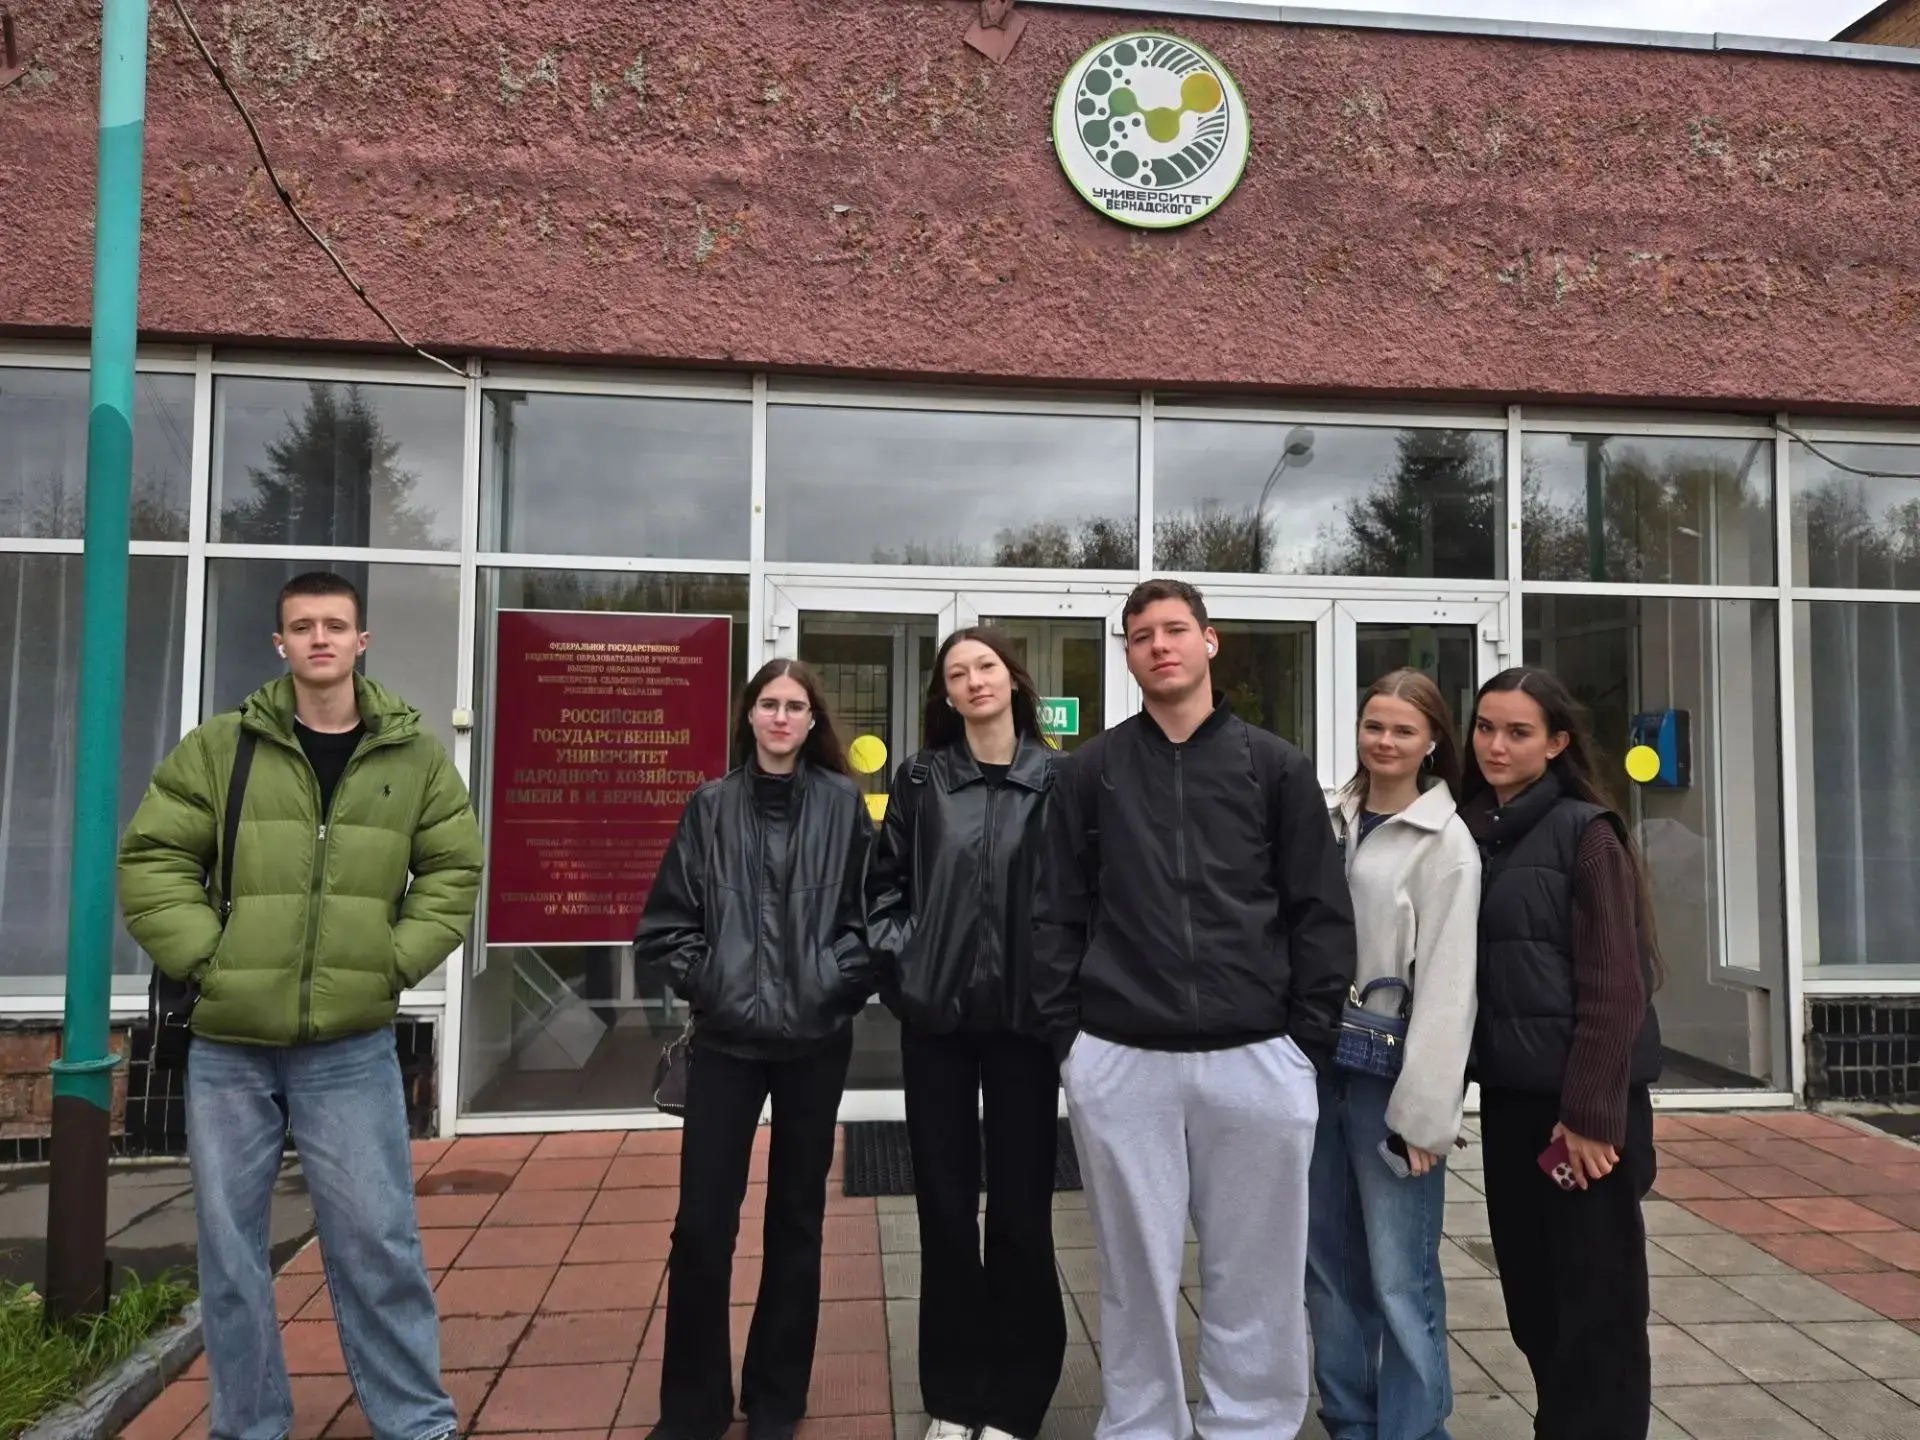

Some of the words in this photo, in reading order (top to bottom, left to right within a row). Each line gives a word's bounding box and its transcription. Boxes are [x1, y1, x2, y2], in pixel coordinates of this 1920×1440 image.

[1092, 187, 1213, 206] УНИВЕРСИТЕТ
[1106, 198, 1193, 215] ВЕРНАДСКОГО
[549, 642, 606, 651] ФЕДЕРАЛЬНОЕ
[607, 643, 680, 653] ГОСУДАРСТВЕННОЕ
[560, 707, 664, 724] РОССИЙСКИЙ
[532, 728, 690, 746] ГОСУДАРСТВЕННЫЙ
[556, 749, 668, 764] УНИВЕРСИТЕТ
[514, 768, 607, 784] НАРОДНОГО
[615, 768, 706, 785] ХОЗЯЙСТВА
[505, 788, 563, 804] ИМЕНИ
[603, 789, 694, 806] ВЕРНАДСКО
